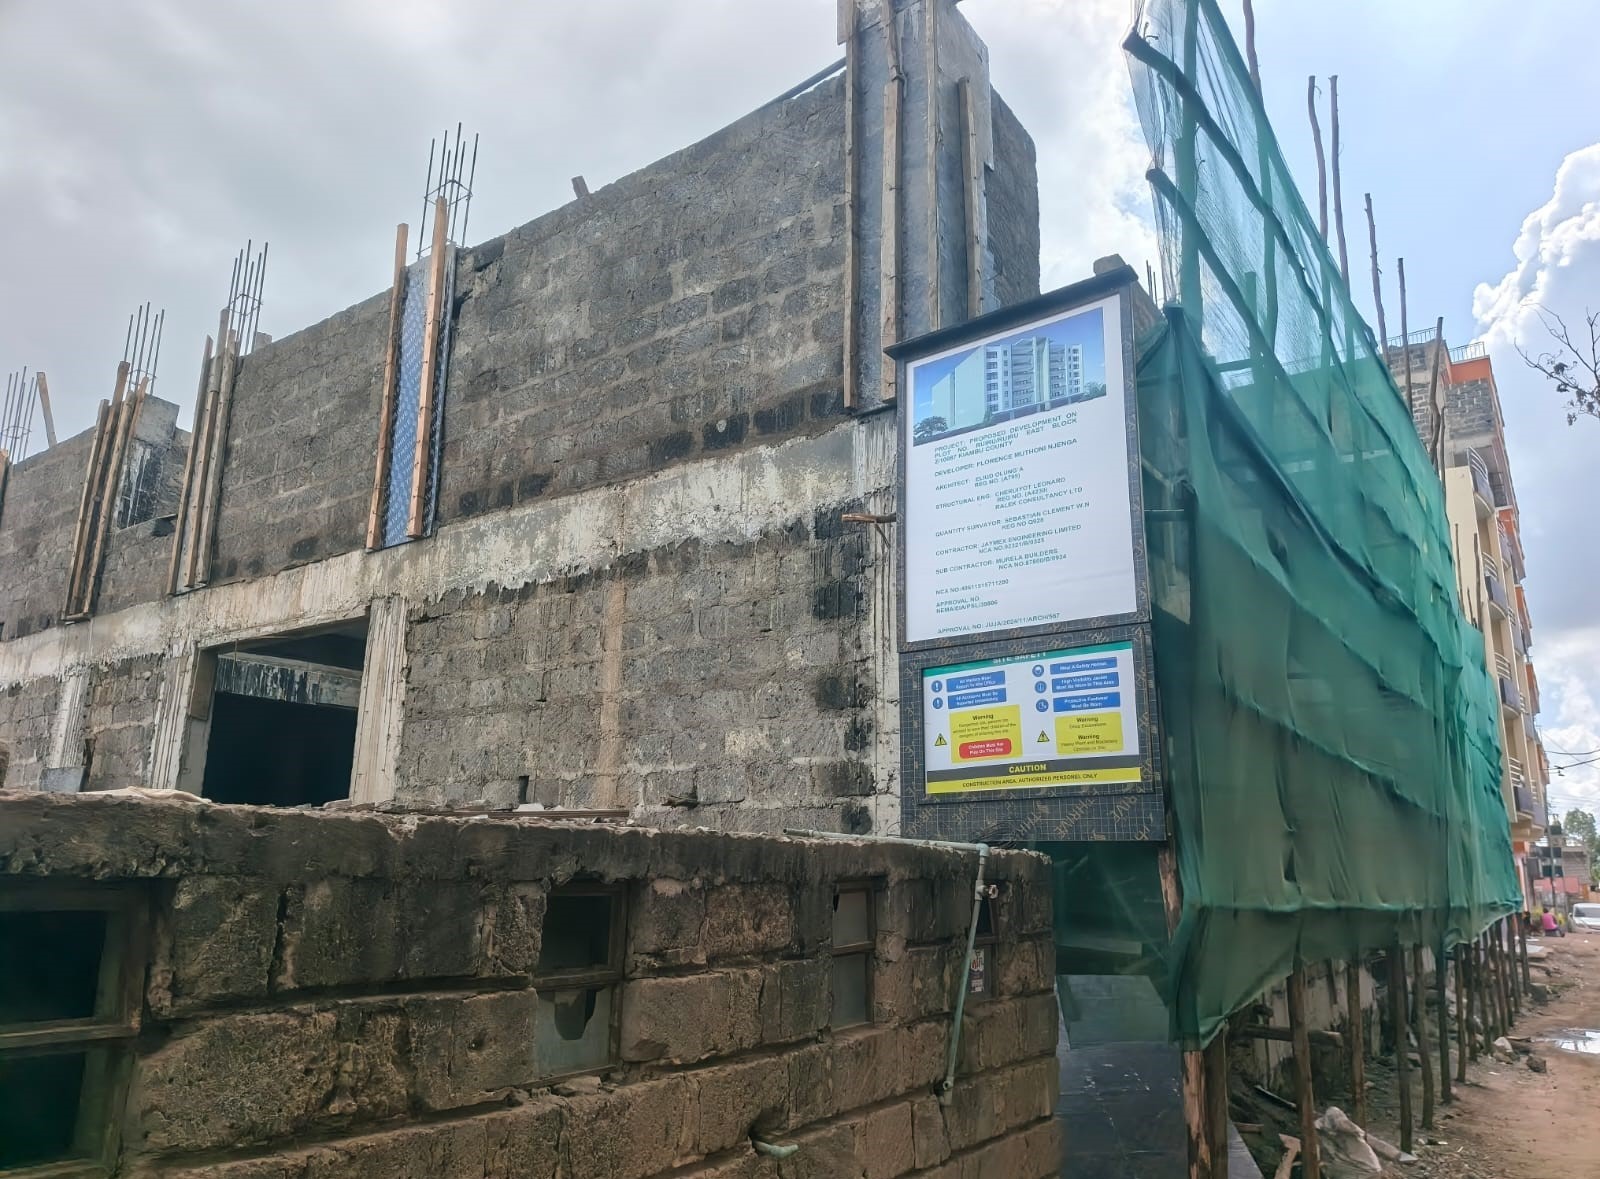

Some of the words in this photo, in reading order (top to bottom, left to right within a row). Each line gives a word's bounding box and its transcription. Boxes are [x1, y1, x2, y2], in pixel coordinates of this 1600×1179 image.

[934, 449, 950, 458] PLOT
[1026, 426, 1043, 435] EAST
[1052, 417, 1076, 428] BLOCK
[969, 429, 1005, 443] PROPOSED
[1009, 415, 1060, 433] DEVELOPMENT
[1066, 410, 1076, 418] ON
[958, 447, 983, 458] KIAMBU
[985, 440, 1012, 451] COUNTY
[977, 452, 1012, 467] FLORENCE
[1014, 445, 1045, 458] MUTHONI
[1047, 437, 1077, 449] NJENGA
[935, 496, 974, 510] STRUCTURAL
[1033, 476, 1065, 488] LEONARD
[1018, 489, 1067, 505] CONSULTANCY
[1069, 486, 1082, 494] LTD
[935, 526, 964, 537] QUANTITY
[1004, 511, 1041, 523] SEBASTIAN
[1042, 504, 1073, 515] CLEMENT
[935, 543, 978, 556] CONTRACTOR:
[1008, 529, 1052, 542] ENGINEERING
[1054, 523, 1081, 533] LIMITED
[1024, 547, 1057, 558] BUILDERS
[936, 597, 968, 607] APPROVAL
[937, 624, 970, 634] APPROVAL
[1008, 763, 1046, 773] CAUTION
